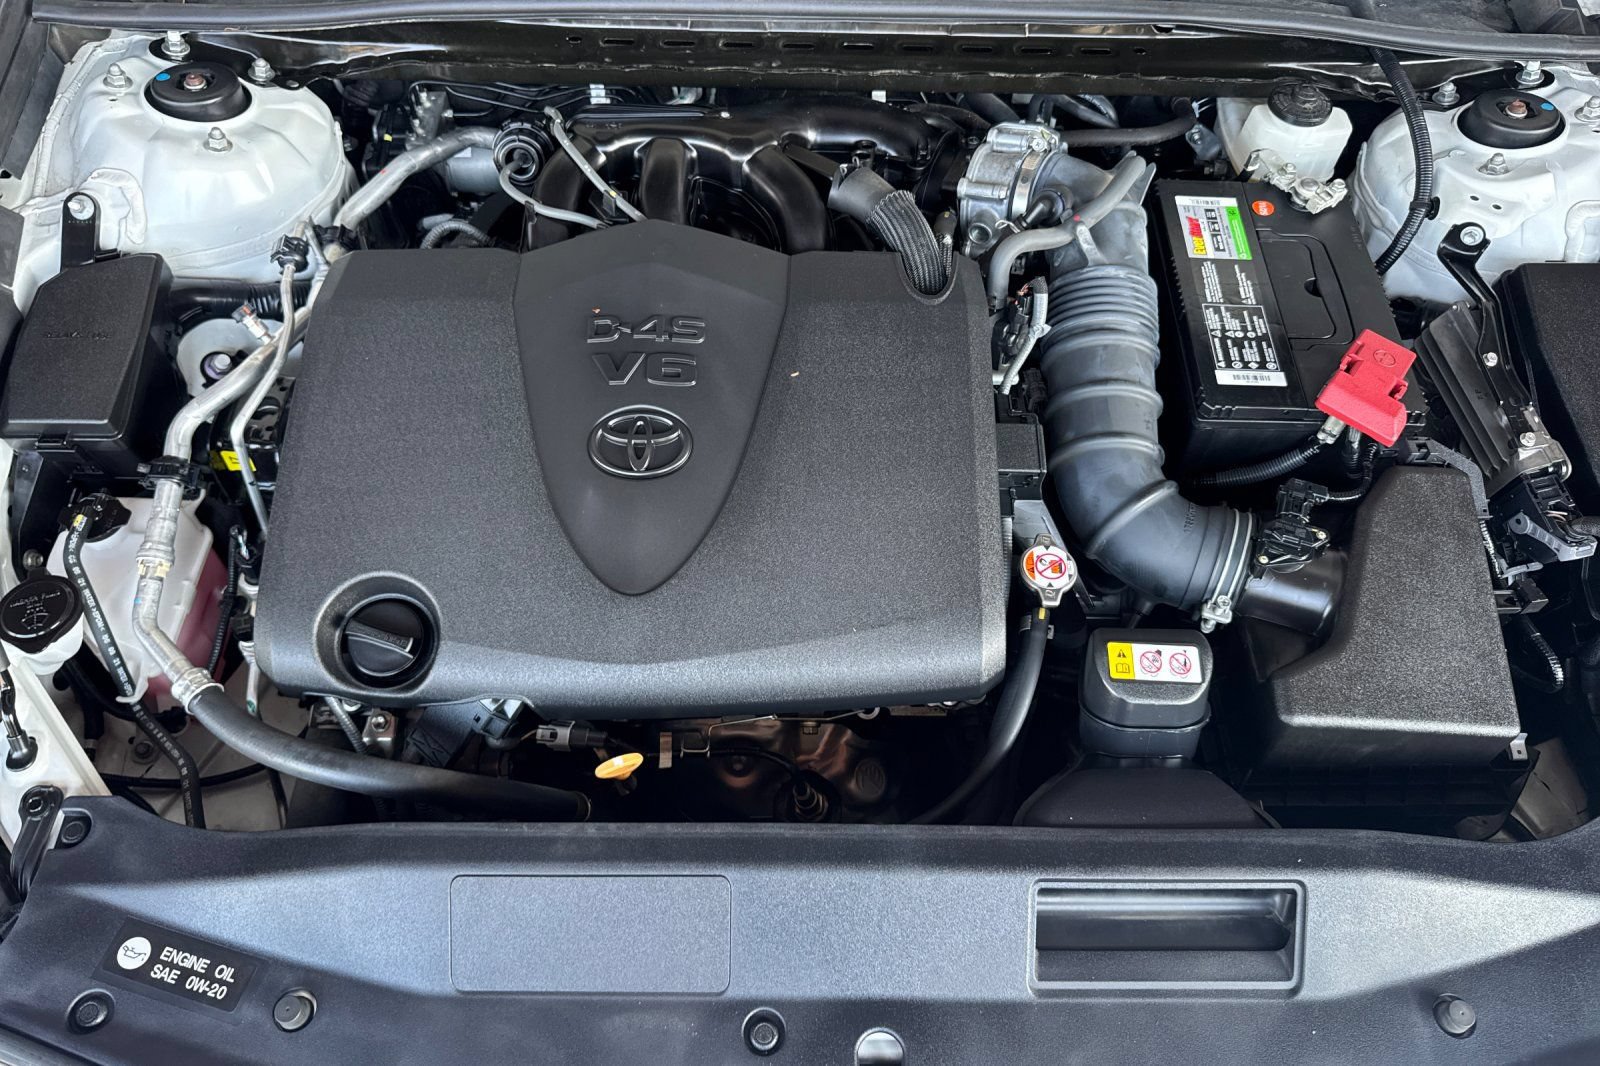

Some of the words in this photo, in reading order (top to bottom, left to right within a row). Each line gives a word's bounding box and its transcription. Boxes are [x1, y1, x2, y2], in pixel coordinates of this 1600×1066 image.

[586, 314, 706, 344] D-4S
[592, 352, 698, 387] V6
[82, 588, 96, 608] WATER
[150, 964, 181, 984] SAE
[185, 975, 228, 1000] 0W-20
[159, 946, 211, 973] ENGINE
[214, 964, 236, 983] OIL
